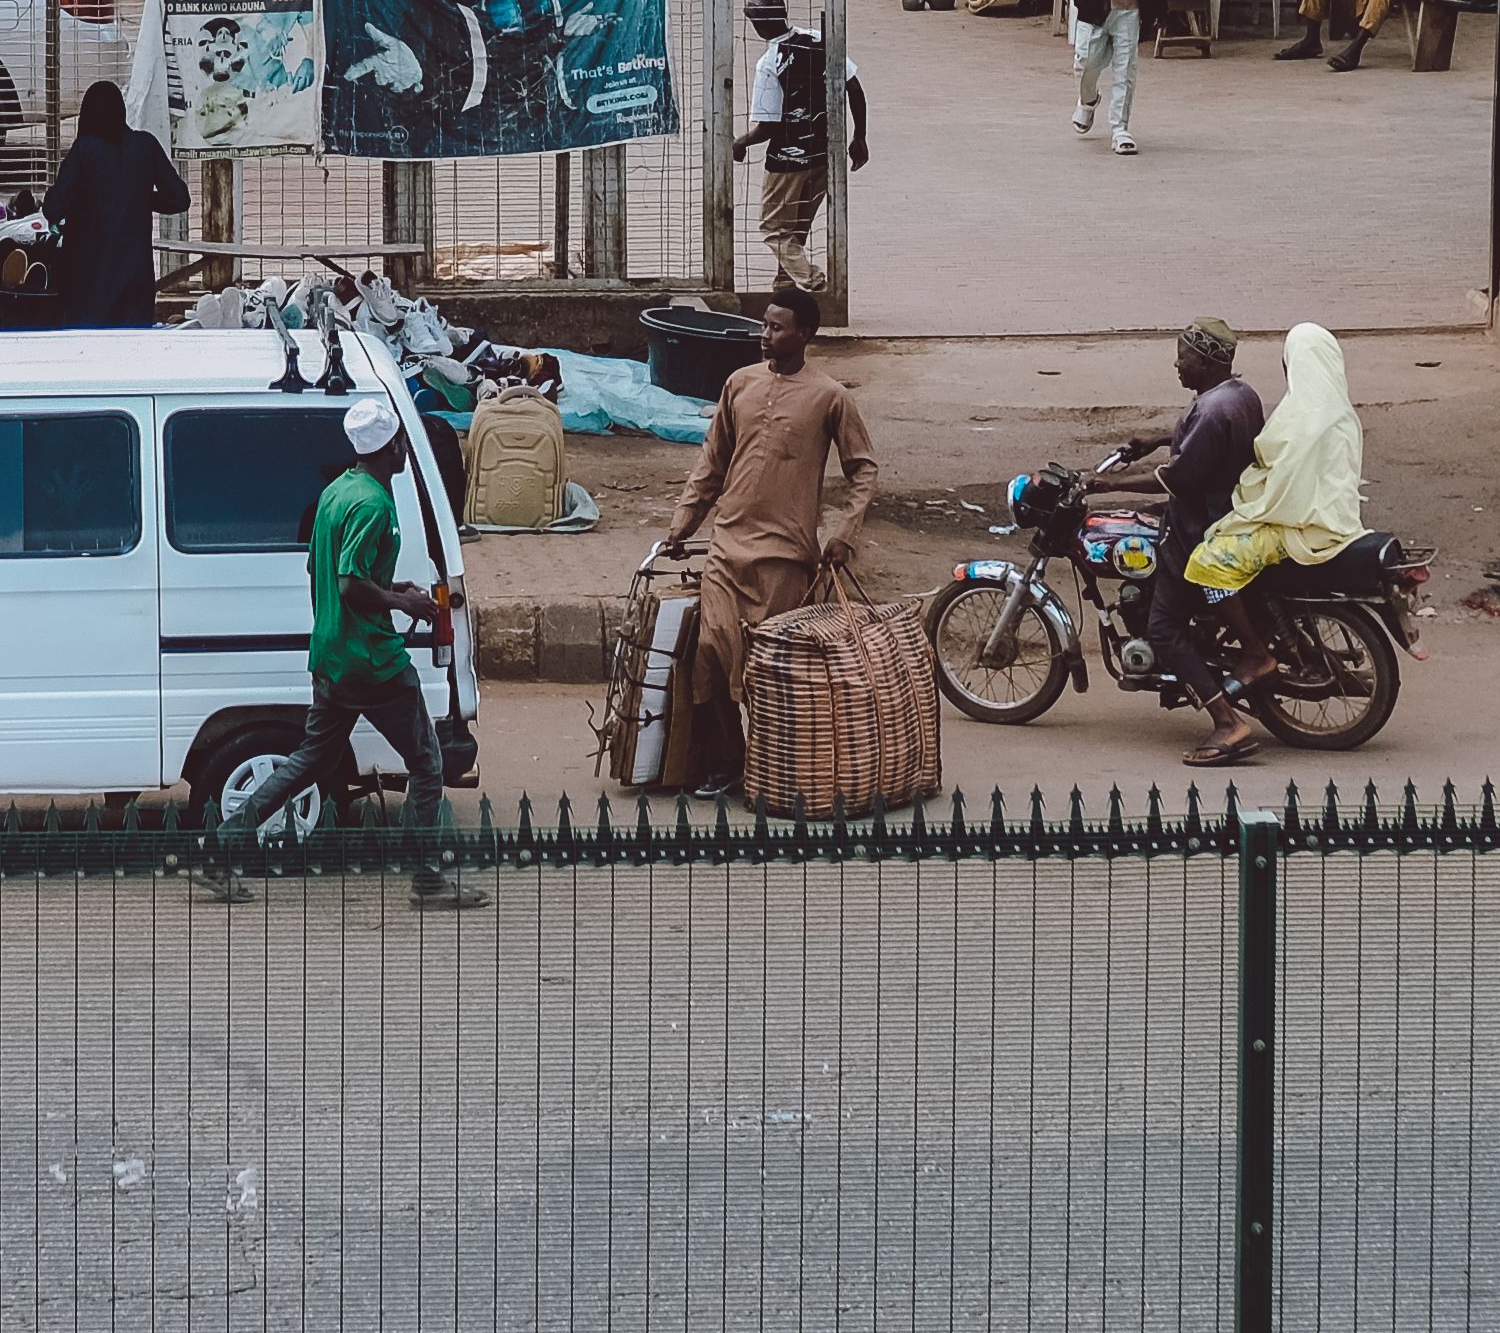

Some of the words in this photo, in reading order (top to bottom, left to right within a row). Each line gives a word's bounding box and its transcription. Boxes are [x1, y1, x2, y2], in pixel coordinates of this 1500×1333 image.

[176, 2, 200, 13] BANK
[202, 2, 228, 13] KAWO
[229, 1, 266, 12] KADUNA
[570, 64, 614, 81] That's
[617, 53, 666, 74] BetKing
